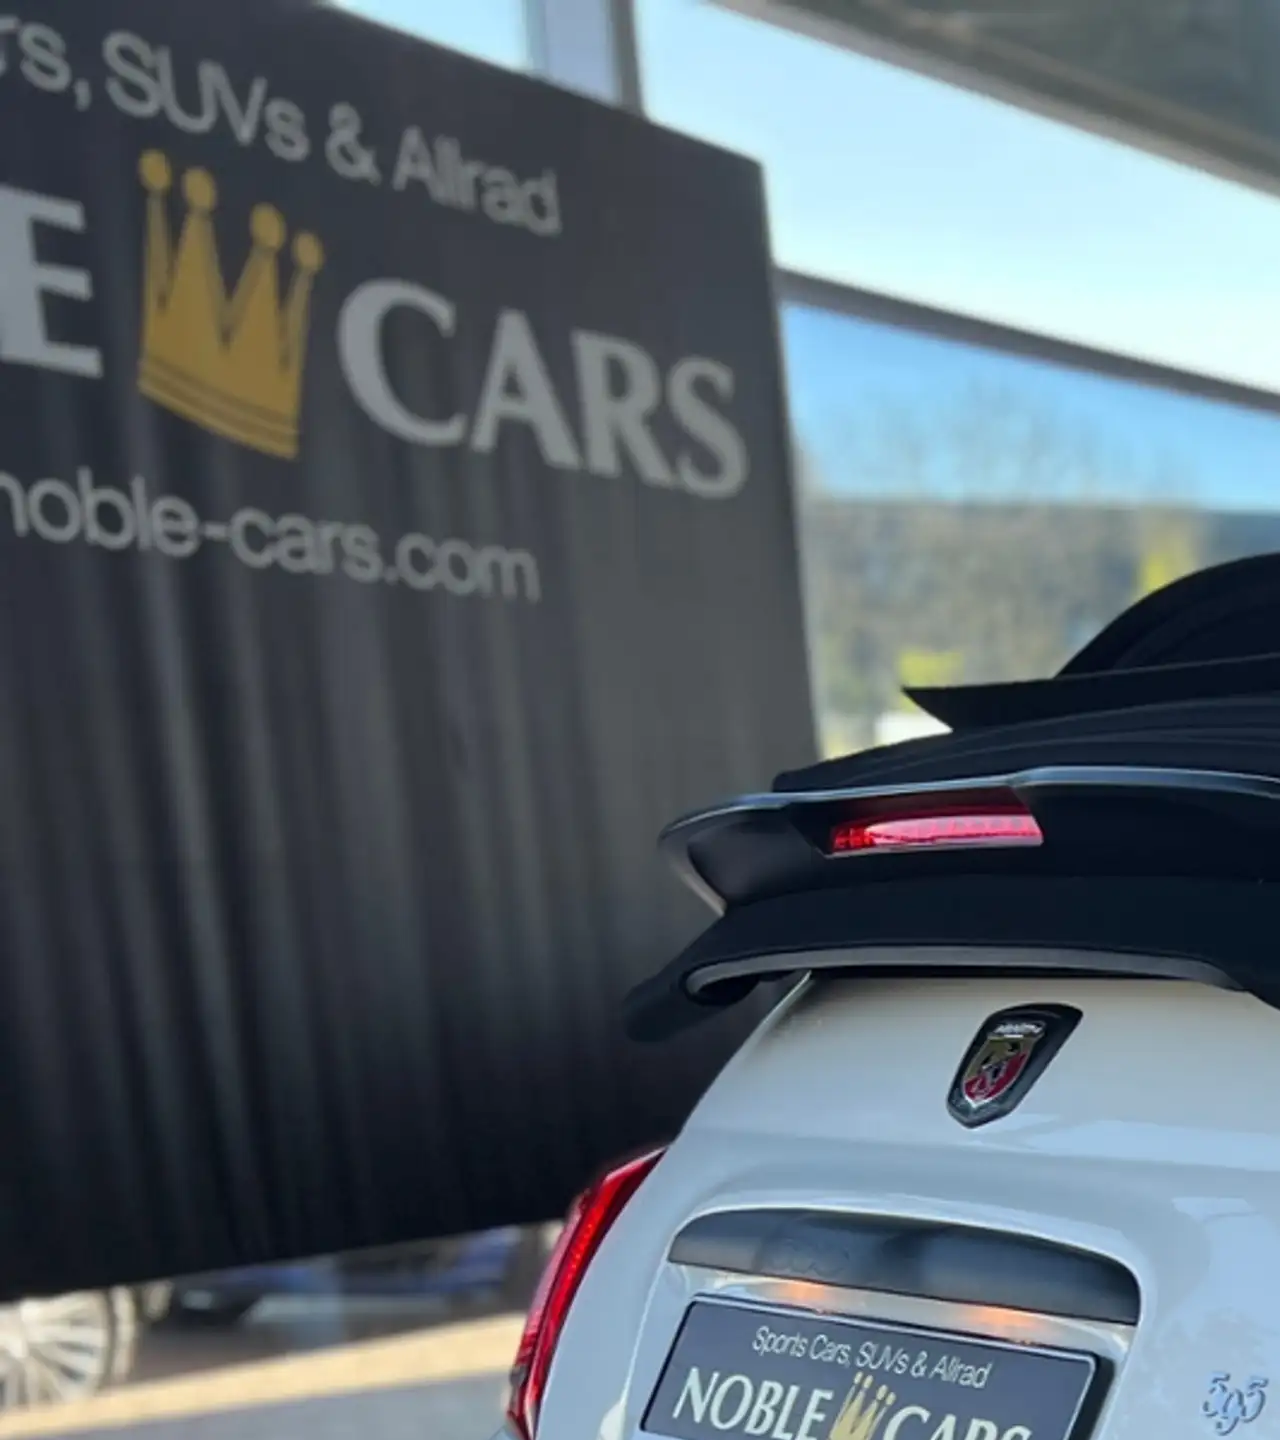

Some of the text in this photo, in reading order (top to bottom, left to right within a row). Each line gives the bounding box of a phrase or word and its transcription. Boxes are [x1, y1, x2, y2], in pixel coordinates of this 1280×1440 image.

[102, 30, 310, 162] SUVs
[325, 101, 382, 186] &
[391, 125, 562, 236] Allrad
[337, 276, 750, 500] CARS
[752, 1325, 994, 1389] Sports Cars, SUVs & Allrad
